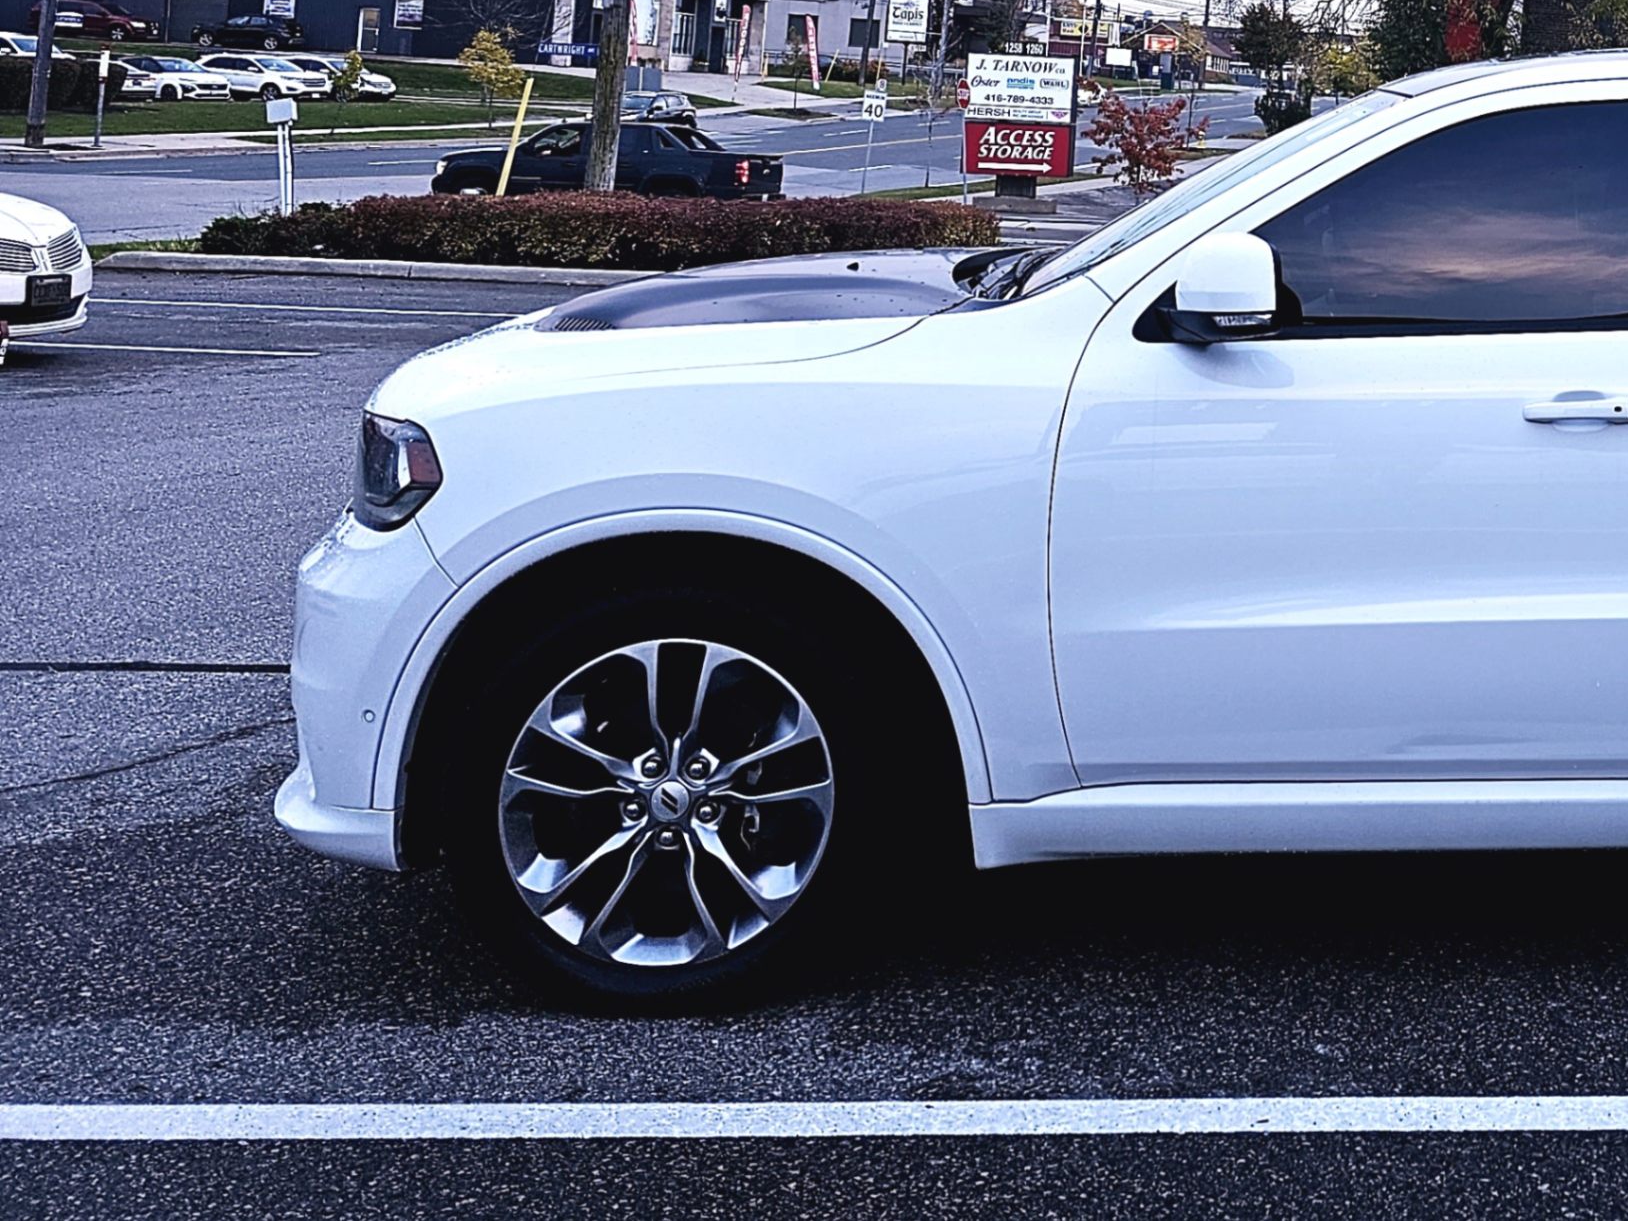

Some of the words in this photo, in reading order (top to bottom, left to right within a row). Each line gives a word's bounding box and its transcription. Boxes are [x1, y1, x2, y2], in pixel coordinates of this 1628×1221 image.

[538, 43, 585, 55] CARTWRIGHT
[976, 59, 987, 70] J.
[992, 59, 1058, 74] TARNOW
[971, 75, 1000, 89] Oster
[1043, 80, 1066, 88] WAHL
[984, 93, 1054, 105] 416-789-4333
[864, 103, 883, 118] 40
[967, 107, 1011, 117] HERSH
[979, 126, 1055, 146] ACCESS
[977, 144, 1054, 160] STORAGE
